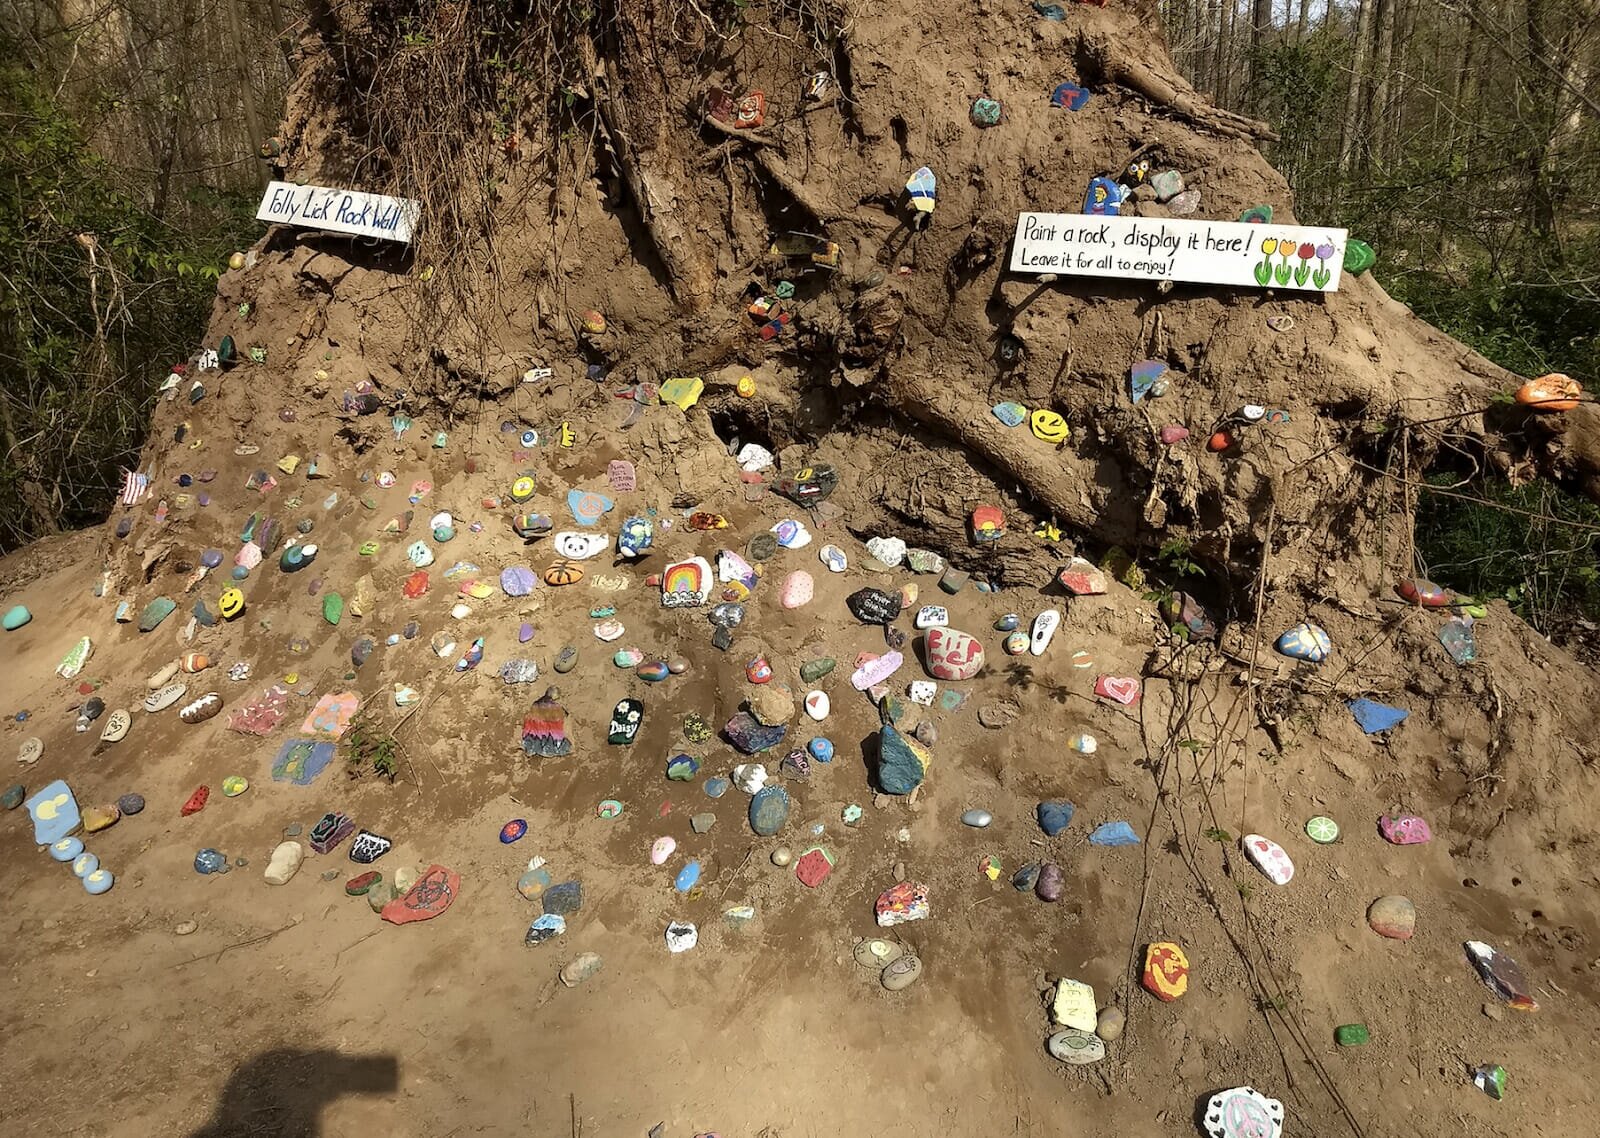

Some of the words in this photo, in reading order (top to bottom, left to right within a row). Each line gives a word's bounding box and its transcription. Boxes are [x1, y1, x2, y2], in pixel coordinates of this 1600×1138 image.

[268, 188, 301, 222] Folly
[302, 188, 334, 220] Lick
[335, 195, 372, 227] Rock
[372, 201, 402, 231] Wall
[1024, 215, 1057, 242] Paint
[1063, 228, 1074, 243] a
[1078, 223, 1116, 248] rock,
[1123, 223, 1182, 258] display
[1187, 232, 1200, 250] it
[1205, 227, 1255, 257] here!
[1021, 248, 1059, 266] Leave
[1061, 251, 1072, 268] it
[1077, 251, 1094, 268] for
[1096, 255, 1113, 270] all
[1117, 258, 1131, 271] to
[1133, 258, 1175, 276] enjoy!
[870, 592, 892, 606] Never
[609, 720, 638, 738] Daisy
